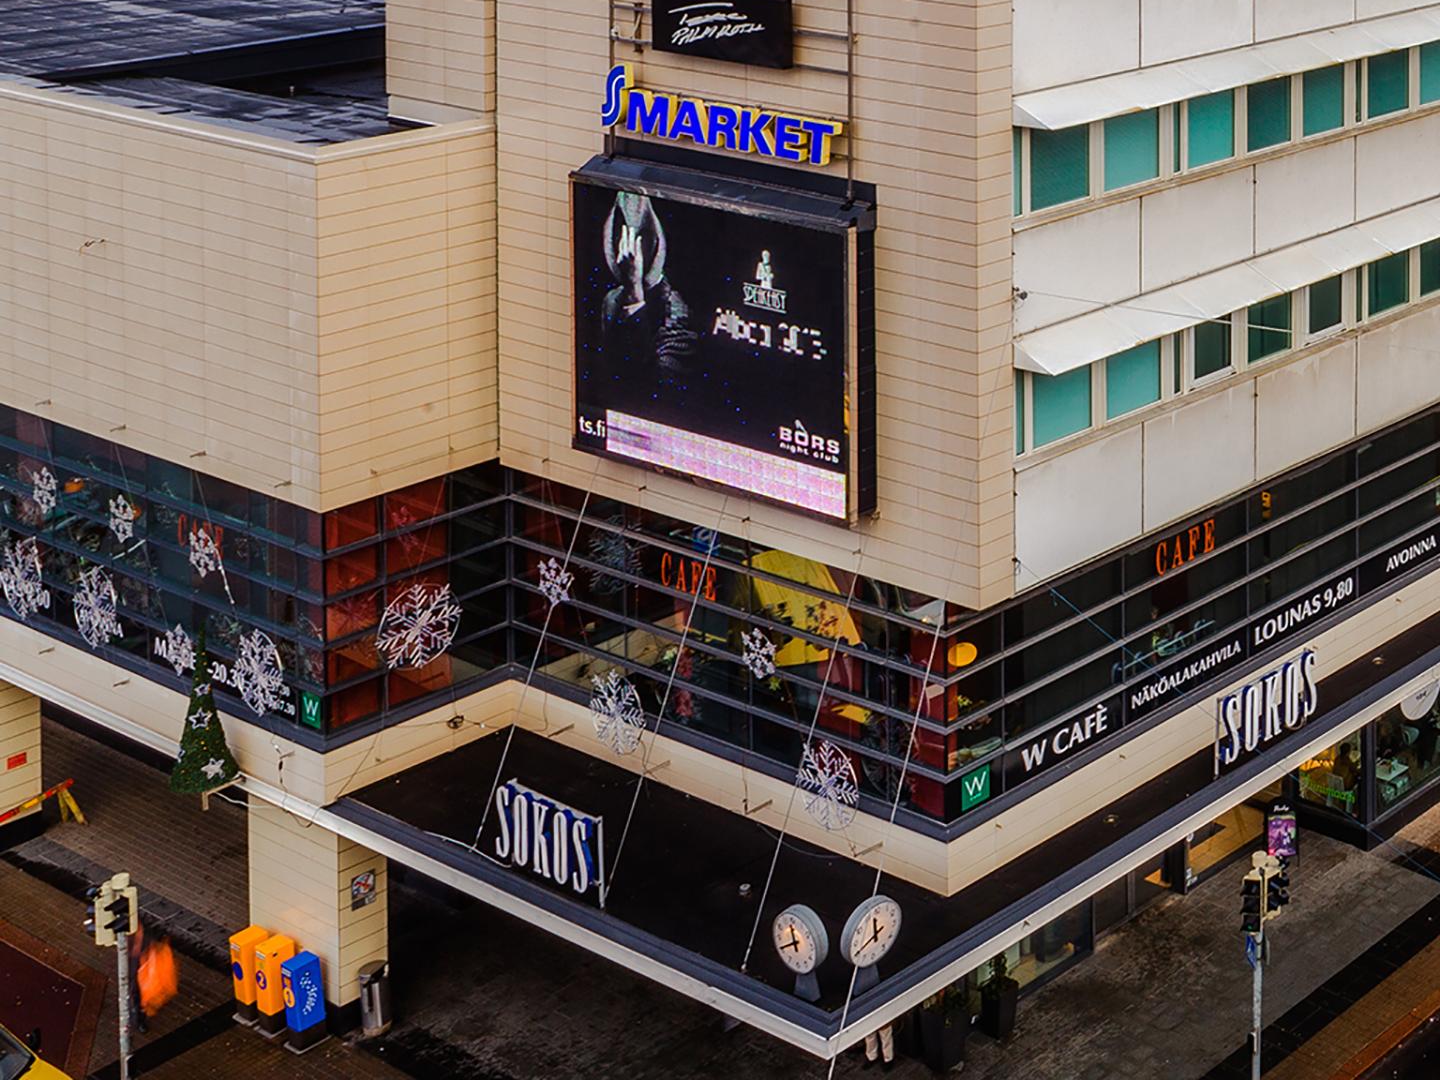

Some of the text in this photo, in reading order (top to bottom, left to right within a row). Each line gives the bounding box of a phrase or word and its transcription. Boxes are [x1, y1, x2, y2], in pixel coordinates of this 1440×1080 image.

[579, 416, 605, 438] ts.fi
[661, 552, 717, 601] CAFE
[1155, 519, 1215, 576] CAFE
[1022, 739, 1047, 772] W
[1131, 639, 1241, 709] NÄKÖALAKAHVILA
[1254, 594, 1322, 646] LOUNAS
[1323, 576, 1353, 610] 9,80
[1386, 534, 1437, 572] AVOINNA
[1221, 651, 1317, 764] SOKOS
[496, 784, 592, 894] SOKOS
